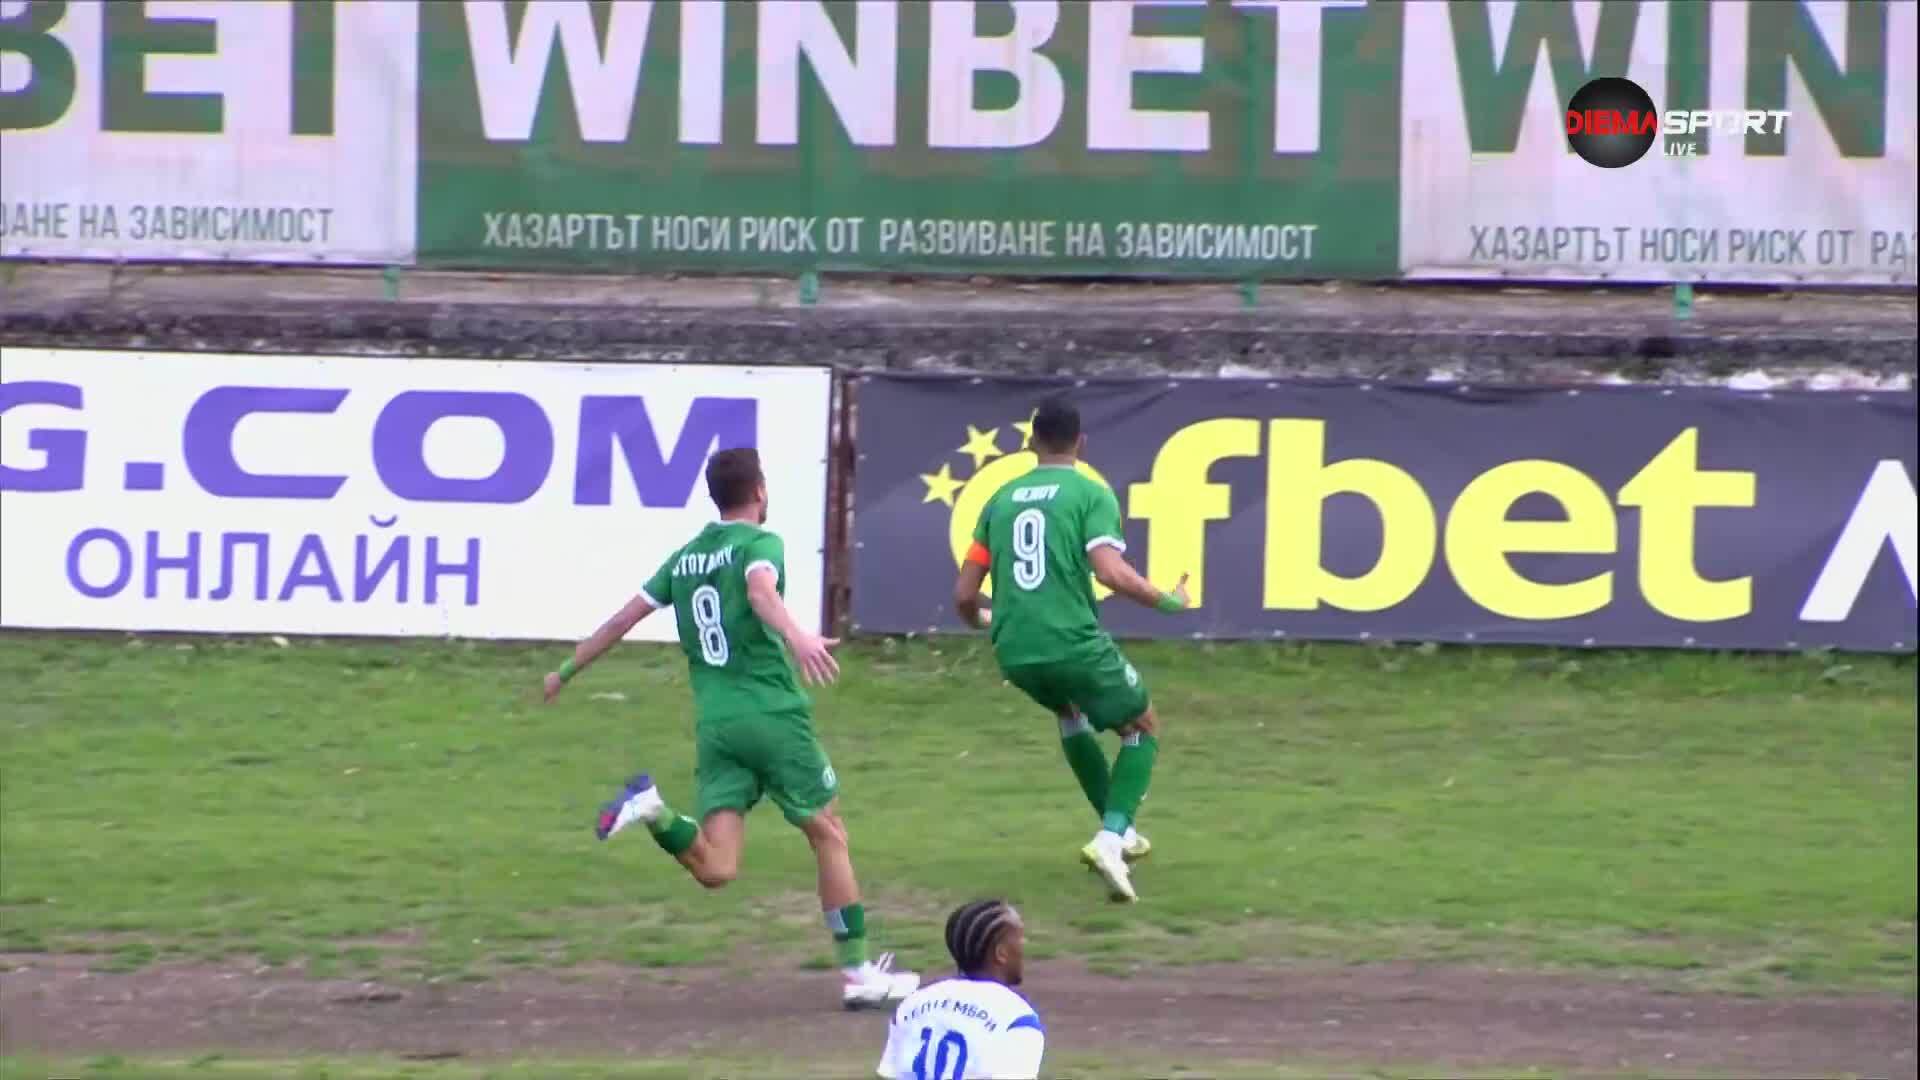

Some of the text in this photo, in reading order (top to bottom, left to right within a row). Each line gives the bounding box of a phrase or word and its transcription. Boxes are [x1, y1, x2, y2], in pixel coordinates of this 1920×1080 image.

[463, 0, 1368, 153] WINBET
[79, 204, 119, 240] НА
[129, 205, 333, 243] ЗАВИСИМОСТ
[483, 212, 1318, 261] ХАЗАРТЪТ НОСИ РИСК ОТ РАЗВИВАНЕ НА ЗАВИСИМОСТ
[1469, 226, 1917, 266] ХАЗАРТЪТ НОСИ РИСК ОТ РА
[65, 514, 480, 606] ОНЛАЙН
[1013, 508, 1046, 591] 9
[692, 584, 729, 667] 8
[911, 1026, 968, 1080] 10
